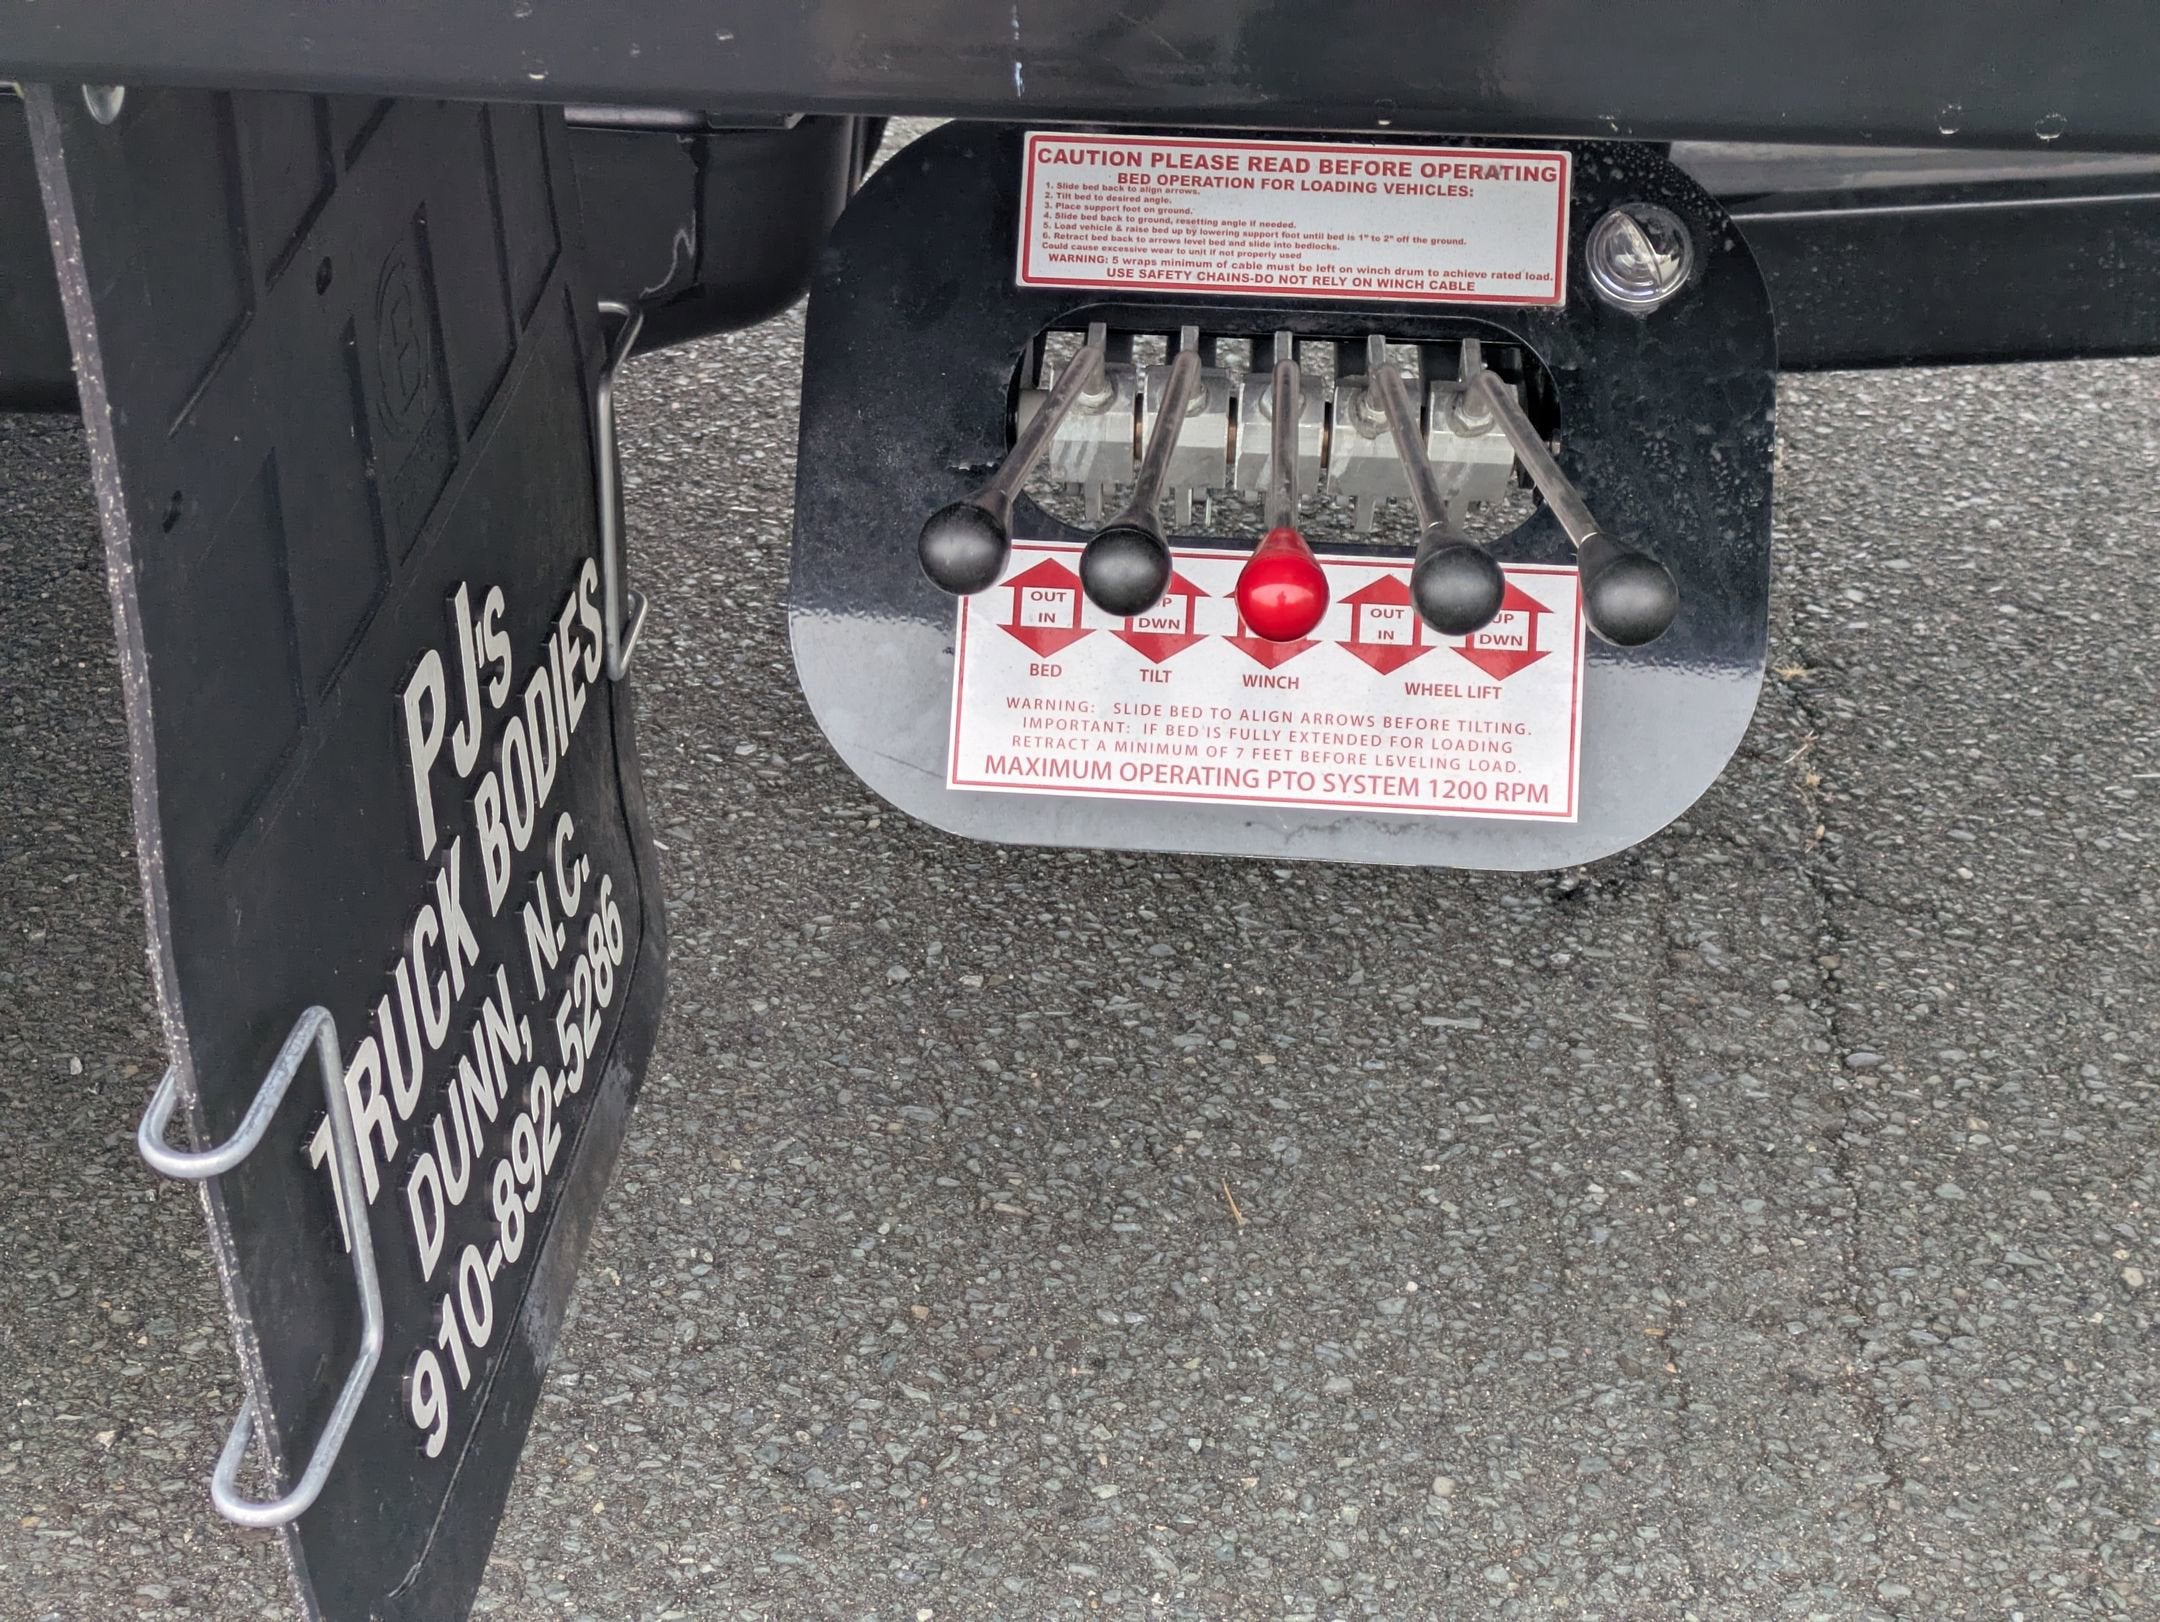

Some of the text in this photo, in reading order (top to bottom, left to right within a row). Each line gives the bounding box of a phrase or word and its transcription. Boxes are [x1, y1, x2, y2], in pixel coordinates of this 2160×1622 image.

[1038, 148, 1557, 182] CAUTION PLEASE READ BEFORE OPERATING
[1118, 172, 1474, 197] BED OPERATION FOR LOADING VEHICLES:
[1140, 186, 1162, 194] align
[1144, 196, 1172, 204] angle.
[1176, 218, 1218, 226] resetting
[1221, 220, 1246, 228] angle
[1260, 220, 1296, 228] needed.
[1200, 228, 1240, 238] lowering
[1249, 240, 1270, 248] slide
[1295, 242, 1340, 250] bedlocks.
[1048, 253, 1109, 264] WARNING:
[1112, 256, 1118, 264] 5
[1122, 258, 1156, 267] wraps
[1161, 259, 1212, 268] minimum
[1216, 260, 1228, 269] of
[1232, 261, 1262, 270] cable
[1266, 263, 1295, 272] must
[1299, 264, 1312, 272] be
[1316, 264, 1335, 273] left
[1356, 266, 1390, 275] winch
[1394, 267, 1424, 276] drum
[1443, 269, 1488, 279] achieve
[1492, 271, 1521, 280] rated
[1525, 272, 1553, 281] load.
[1107, 268, 1134, 278] USE
[1139, 270, 1192, 280] SAFETY
[1279, 274, 1308, 284] NOT
[1312, 276, 1347, 286] RELY
[1352, 278, 1372, 288] ON
[1377, 278, 1424, 290] WINCH
[1429, 280, 1475, 291] CABLE
[1030, 590, 1067, 602] OUT
[1162, 598, 1172, 607] P
[1038, 612, 1056, 623] IN
[1370, 608, 1404, 620] OUT
[1138, 617, 1180, 630] DWN
[1378, 629, 1395, 640] IN
[1479, 634, 1523, 647] DWN
[1030, 663, 1062, 678] BED
[1140, 669, 1172, 684] TILT
[1242, 674, 1300, 690] WINCH
[1405, 682, 1502, 700] WHEEL LIFT
[1006, 697, 1532, 736] WARNING: SLIDE BED TO ALIGN ARROWS BEFORE TILTING.
[474, 557, 601, 918] BODIES
[1022, 717, 1513, 754] IMPORTANT: IF BED IS FULLY EXTENDED FOR LOADING
[1012, 735, 1522, 774] RETRACT A MINIMUM OF 7 FEET BEFORE LEVELING LOAD.
[985, 754, 1549, 803] MAXIMUM OPERATING PTO SYSTEM 1200 RPM
[408, 964, 532, 1282] DUNN,
[410, 874, 624, 1458] 910-892-5286
